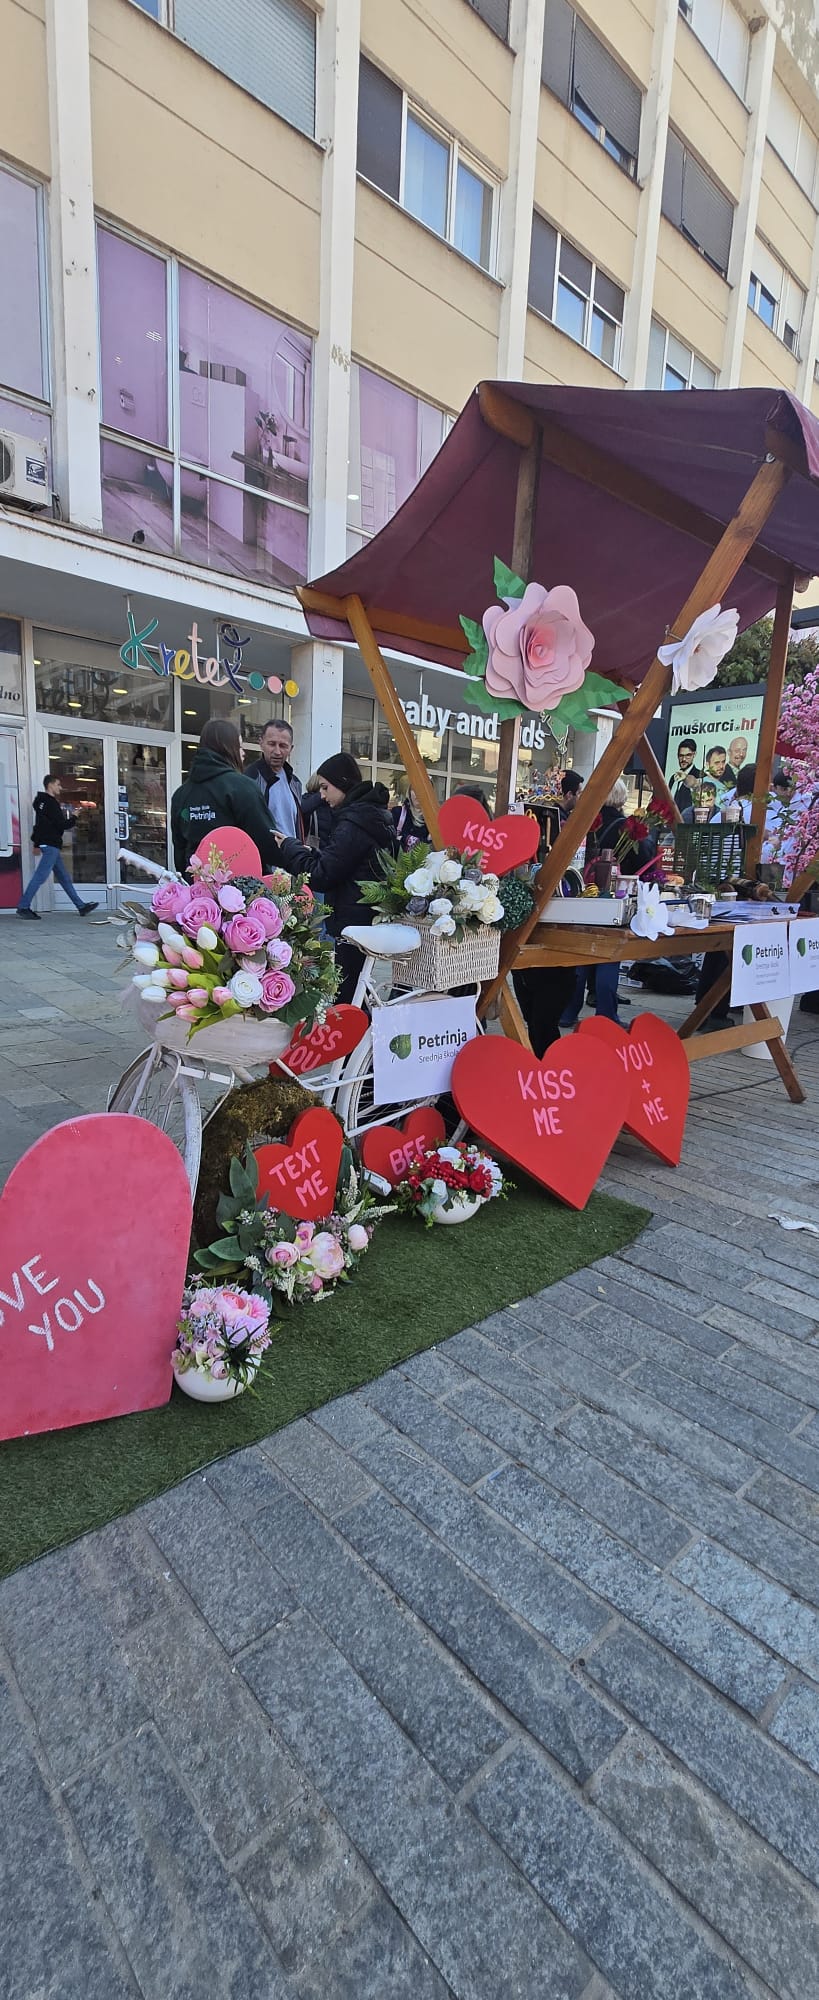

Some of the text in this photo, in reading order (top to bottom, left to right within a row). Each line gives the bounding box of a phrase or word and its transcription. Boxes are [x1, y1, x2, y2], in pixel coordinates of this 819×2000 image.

[456, 712, 499, 741] and
[190, 810, 216, 821] Petrinja
[463, 821, 508, 851] KISS
[755, 943, 784, 960] Petrinja
[808, 940, 819, 950] Pet
[304, 1021, 343, 1051] ISS
[418, 1028, 467, 1049] Petrinja
[419, 1052, 443, 1064] Srednja
[615, 1040, 654, 1073] YOU
[517, 1069, 576, 1100] KISS
[641, 1078, 651, 1094] +
[532, 1106, 563, 1137] ME
[642, 1096, 669, 1126] ME
[268, 1139, 321, 1186] TEXT
[295, 1170, 329, 1208] ME
[0, 1254, 60, 1327] VE
[28, 1278, 106, 1351] YOU
